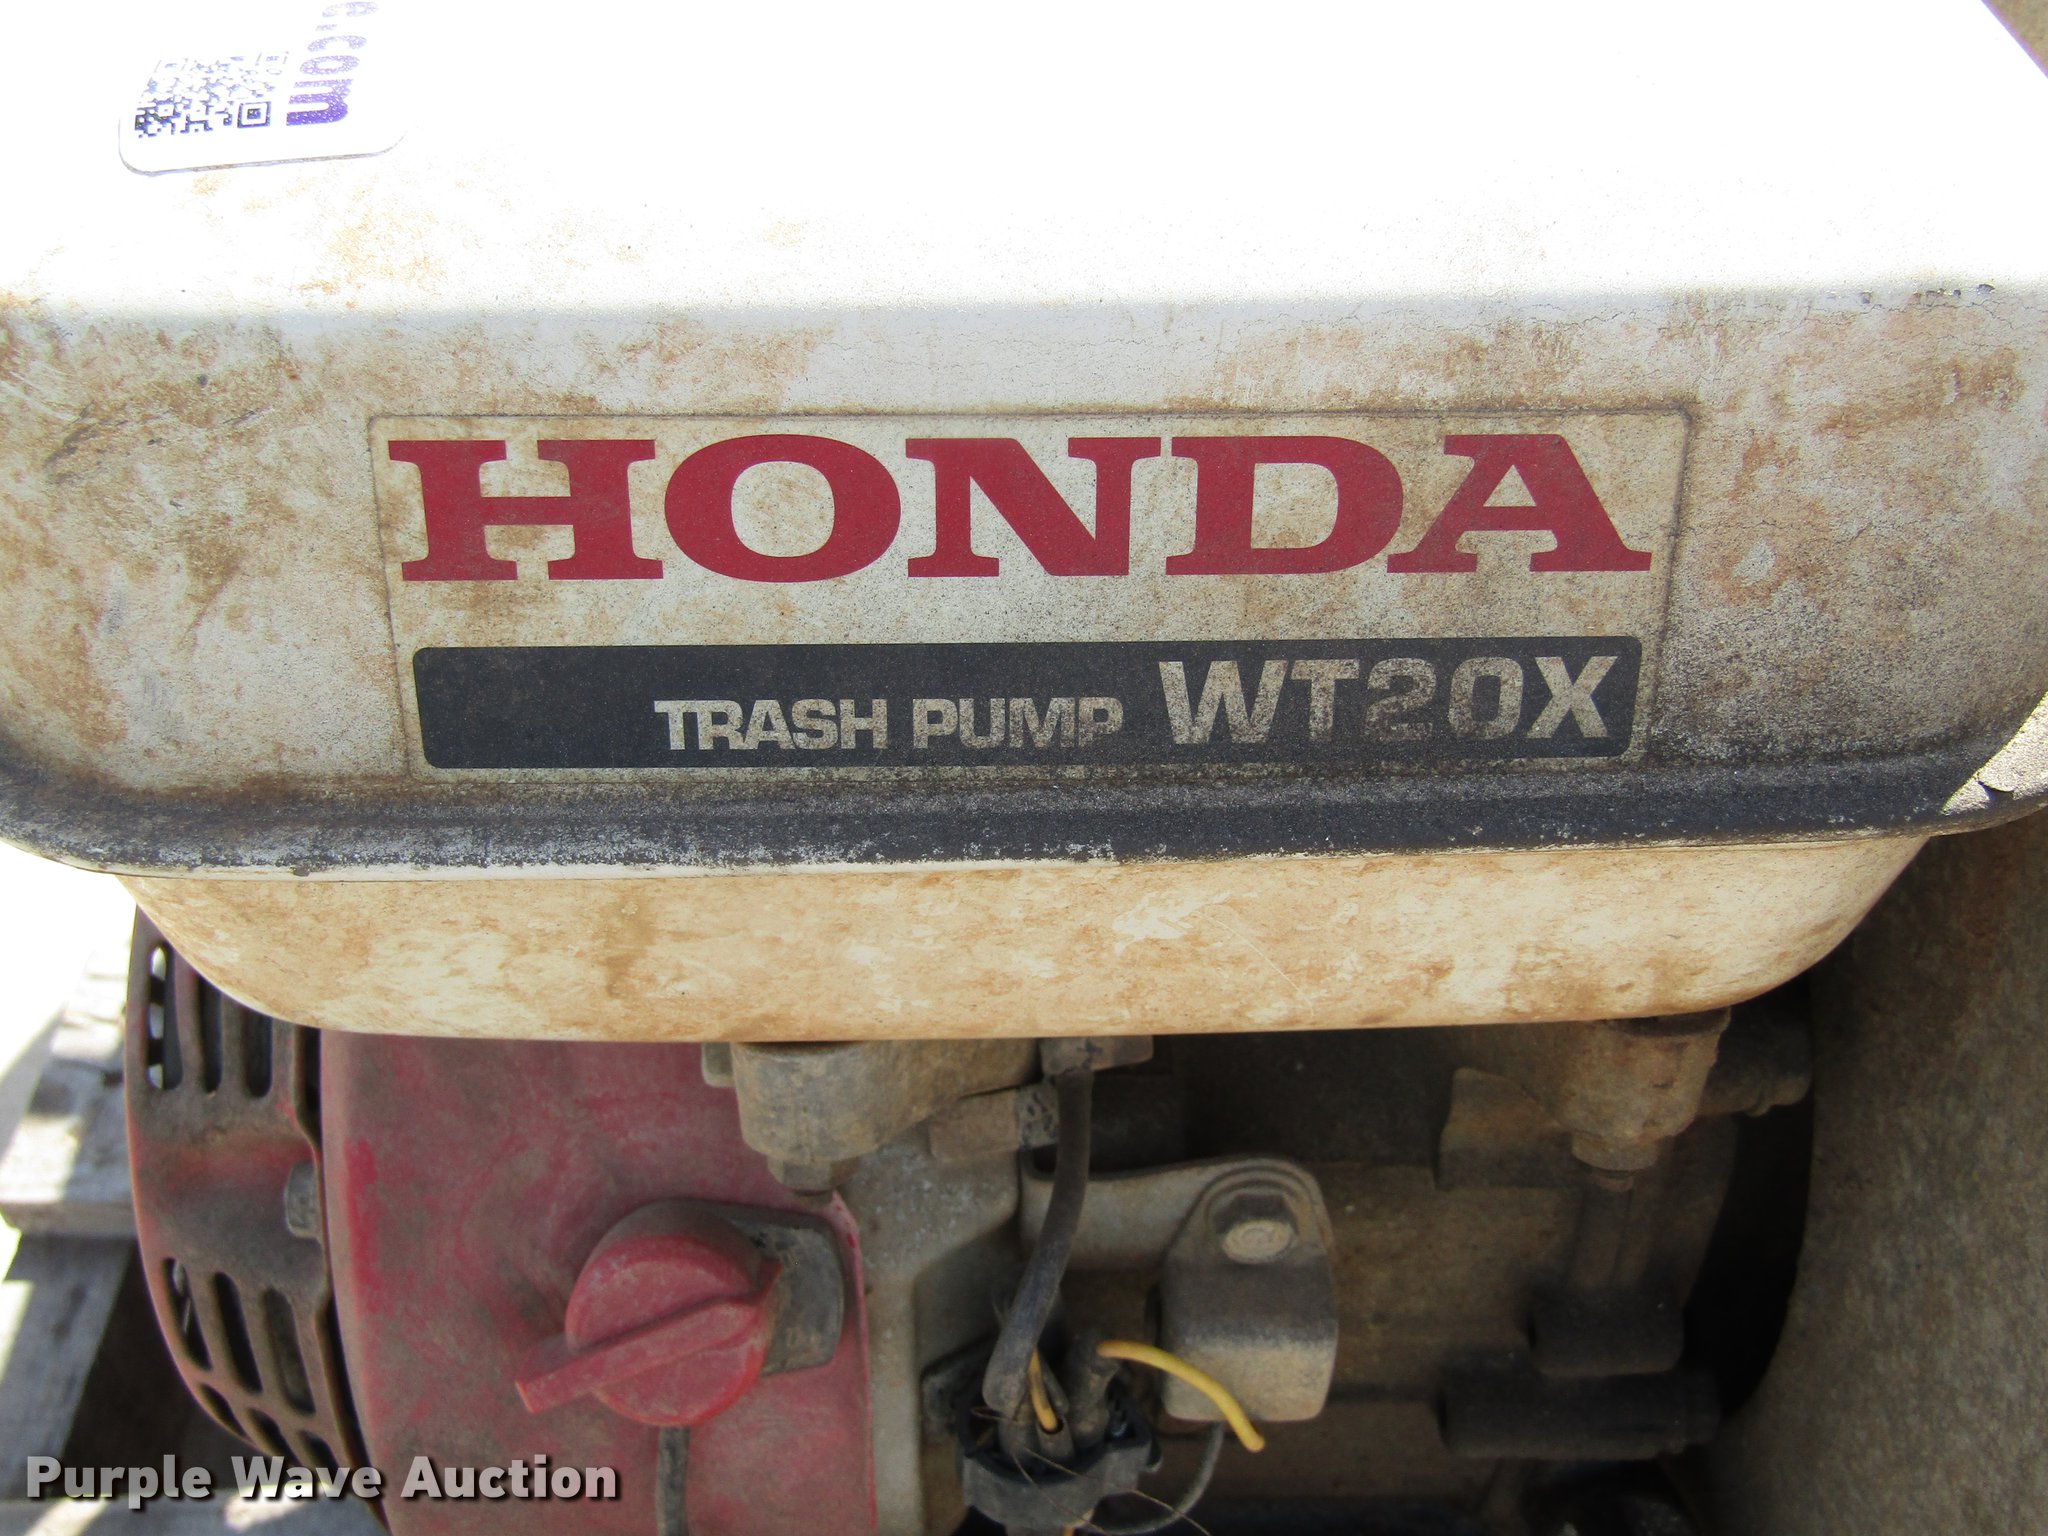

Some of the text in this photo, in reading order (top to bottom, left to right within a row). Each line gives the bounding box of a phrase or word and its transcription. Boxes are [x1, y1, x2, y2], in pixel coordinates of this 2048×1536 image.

[388, 433, 1653, 582] HONDA
[653, 655, 1619, 751] TRASH PUMP WT20X
